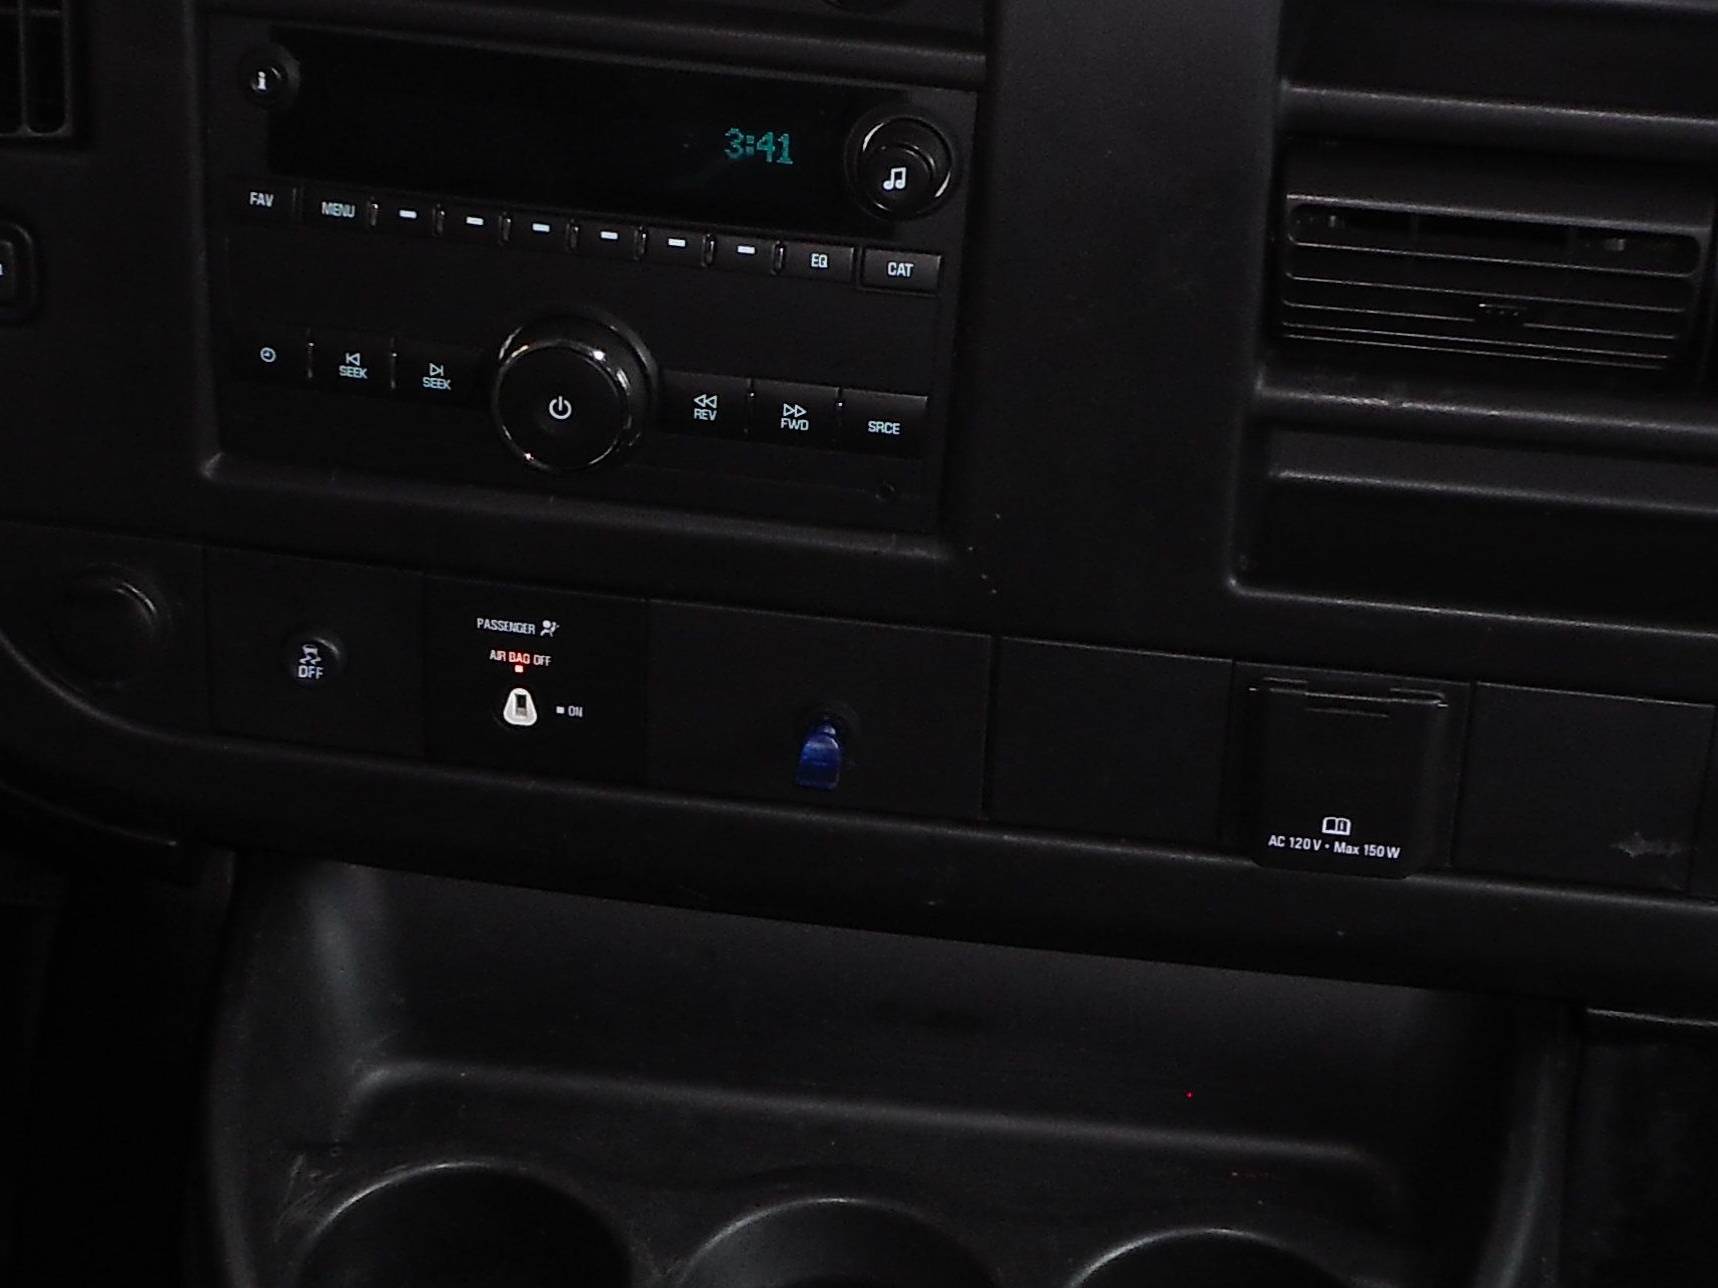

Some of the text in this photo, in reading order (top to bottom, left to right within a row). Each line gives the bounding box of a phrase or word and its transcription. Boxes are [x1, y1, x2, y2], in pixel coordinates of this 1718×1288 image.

[723, 127, 794, 164] 3:41
[249, 191, 274, 207] FAV
[321, 201, 356, 218] MENU
[811, 253, 828, 268] EQ
[887, 262, 914, 278] CAT
[339, 365, 368, 380] SEEK
[422, 376, 452, 391] SEEK
[693, 408, 717, 422] REV
[780, 418, 809, 432] FWD
[867, 420, 901, 435] SRCE
[476, 617, 536, 635] PASSENGER
[489, 649, 552, 668] AIR BAG OFF
[298, 665, 324, 680] OFF
[567, 705, 583, 718] ON
[1268, 834, 1286, 848] AC
[1333, 841, 1360, 856] Max
